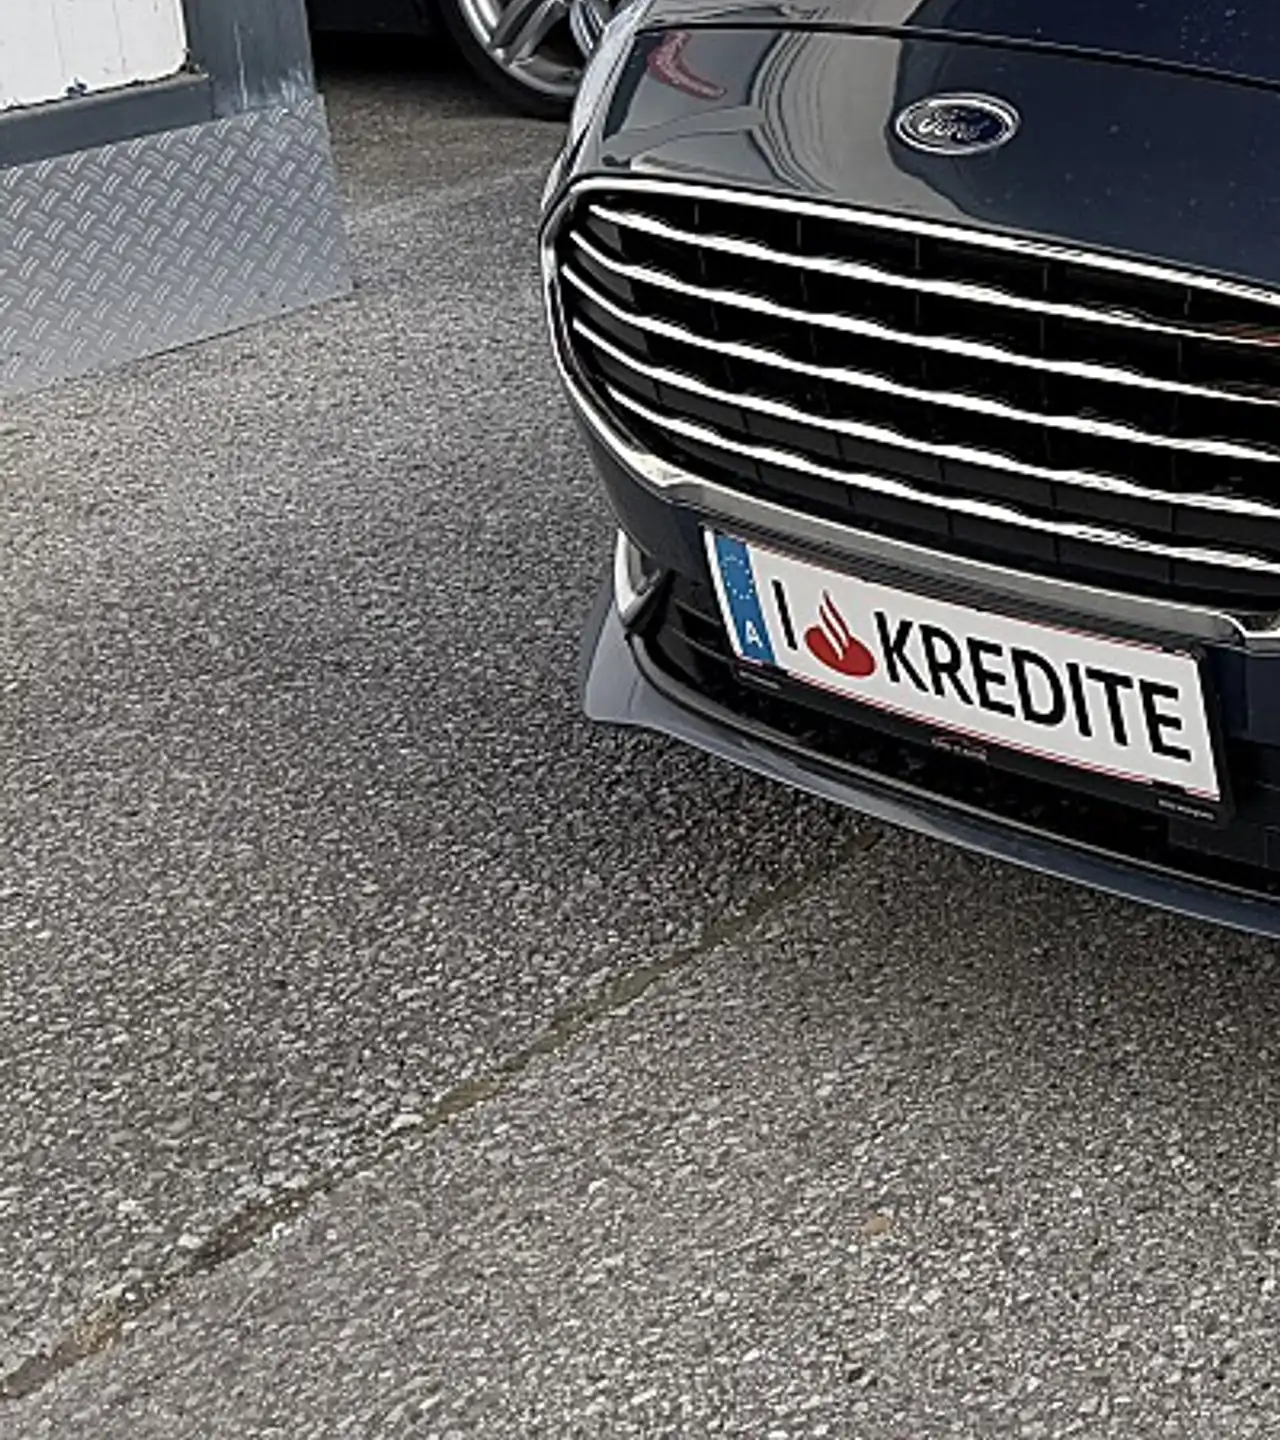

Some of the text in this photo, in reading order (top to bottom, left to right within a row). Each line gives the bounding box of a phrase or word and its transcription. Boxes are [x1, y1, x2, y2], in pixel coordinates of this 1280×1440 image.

[744, 620, 765, 647] A
[772, 580, 1192, 762] I KREDITE
